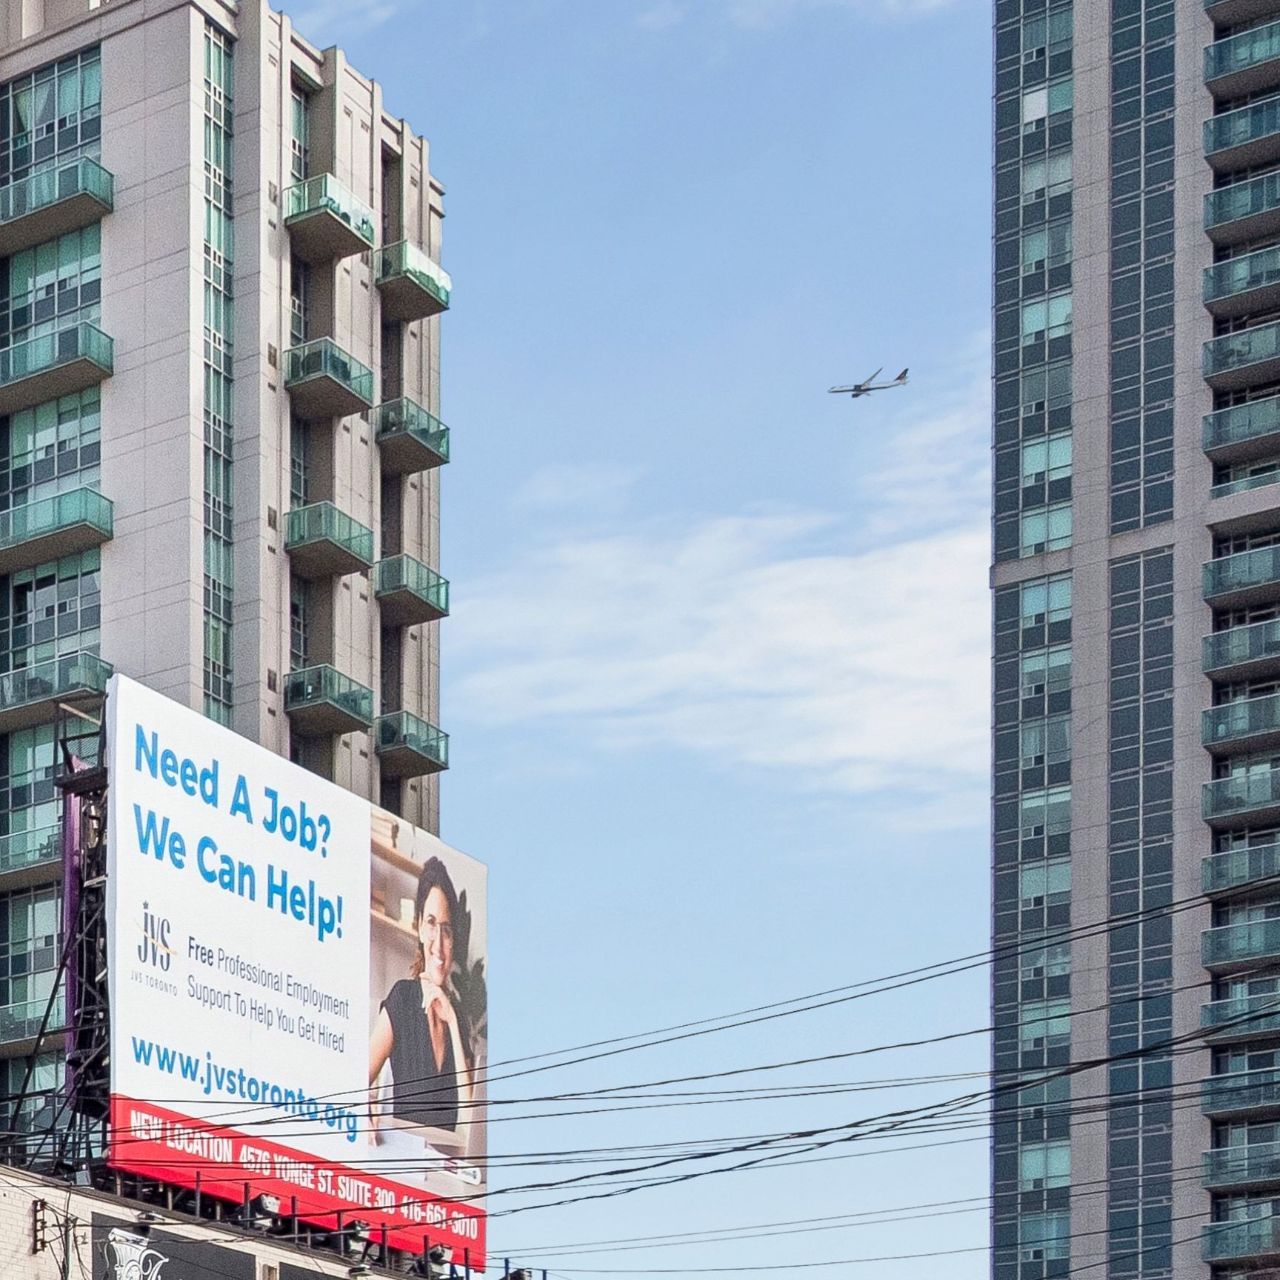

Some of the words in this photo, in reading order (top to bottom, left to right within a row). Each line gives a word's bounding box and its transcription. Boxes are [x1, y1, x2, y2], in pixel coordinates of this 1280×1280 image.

[135, 723, 219, 808] Need
[229, 774, 253, 825] A
[262, 786, 331, 858] Job?
[133, 803, 187, 869] We
[197, 835, 256, 902] Can
[267, 863, 343, 942] Help!
[130, 970, 143, 984] JVS
[145, 974, 178, 996] TORONTO
[187, 974, 231, 1012] Support
[234, 991, 246, 1017] To
[249, 997, 273, 1031] Help
[275, 1006, 294, 1034] You
[297, 1015, 316, 1043] Get
[318, 1023, 345, 1053] Hired
[188, 936, 214, 967] Free
[217, 947, 283, 993] Professional
[286, 974, 350, 1020] Employment
[131, 1036, 358, 1143] www.jvstoronto.org
[130, 1109, 163, 1143] NEW
[166, 1119, 233, 1163] LOCATION
[239, 1144, 271, 1176] 4576
[272, 1153, 315, 1191] YONGE
[317, 1169, 335, 1195] ST.
[337, 1176, 372, 1207] SUITE
[374, 1186, 396, 1215] 300
